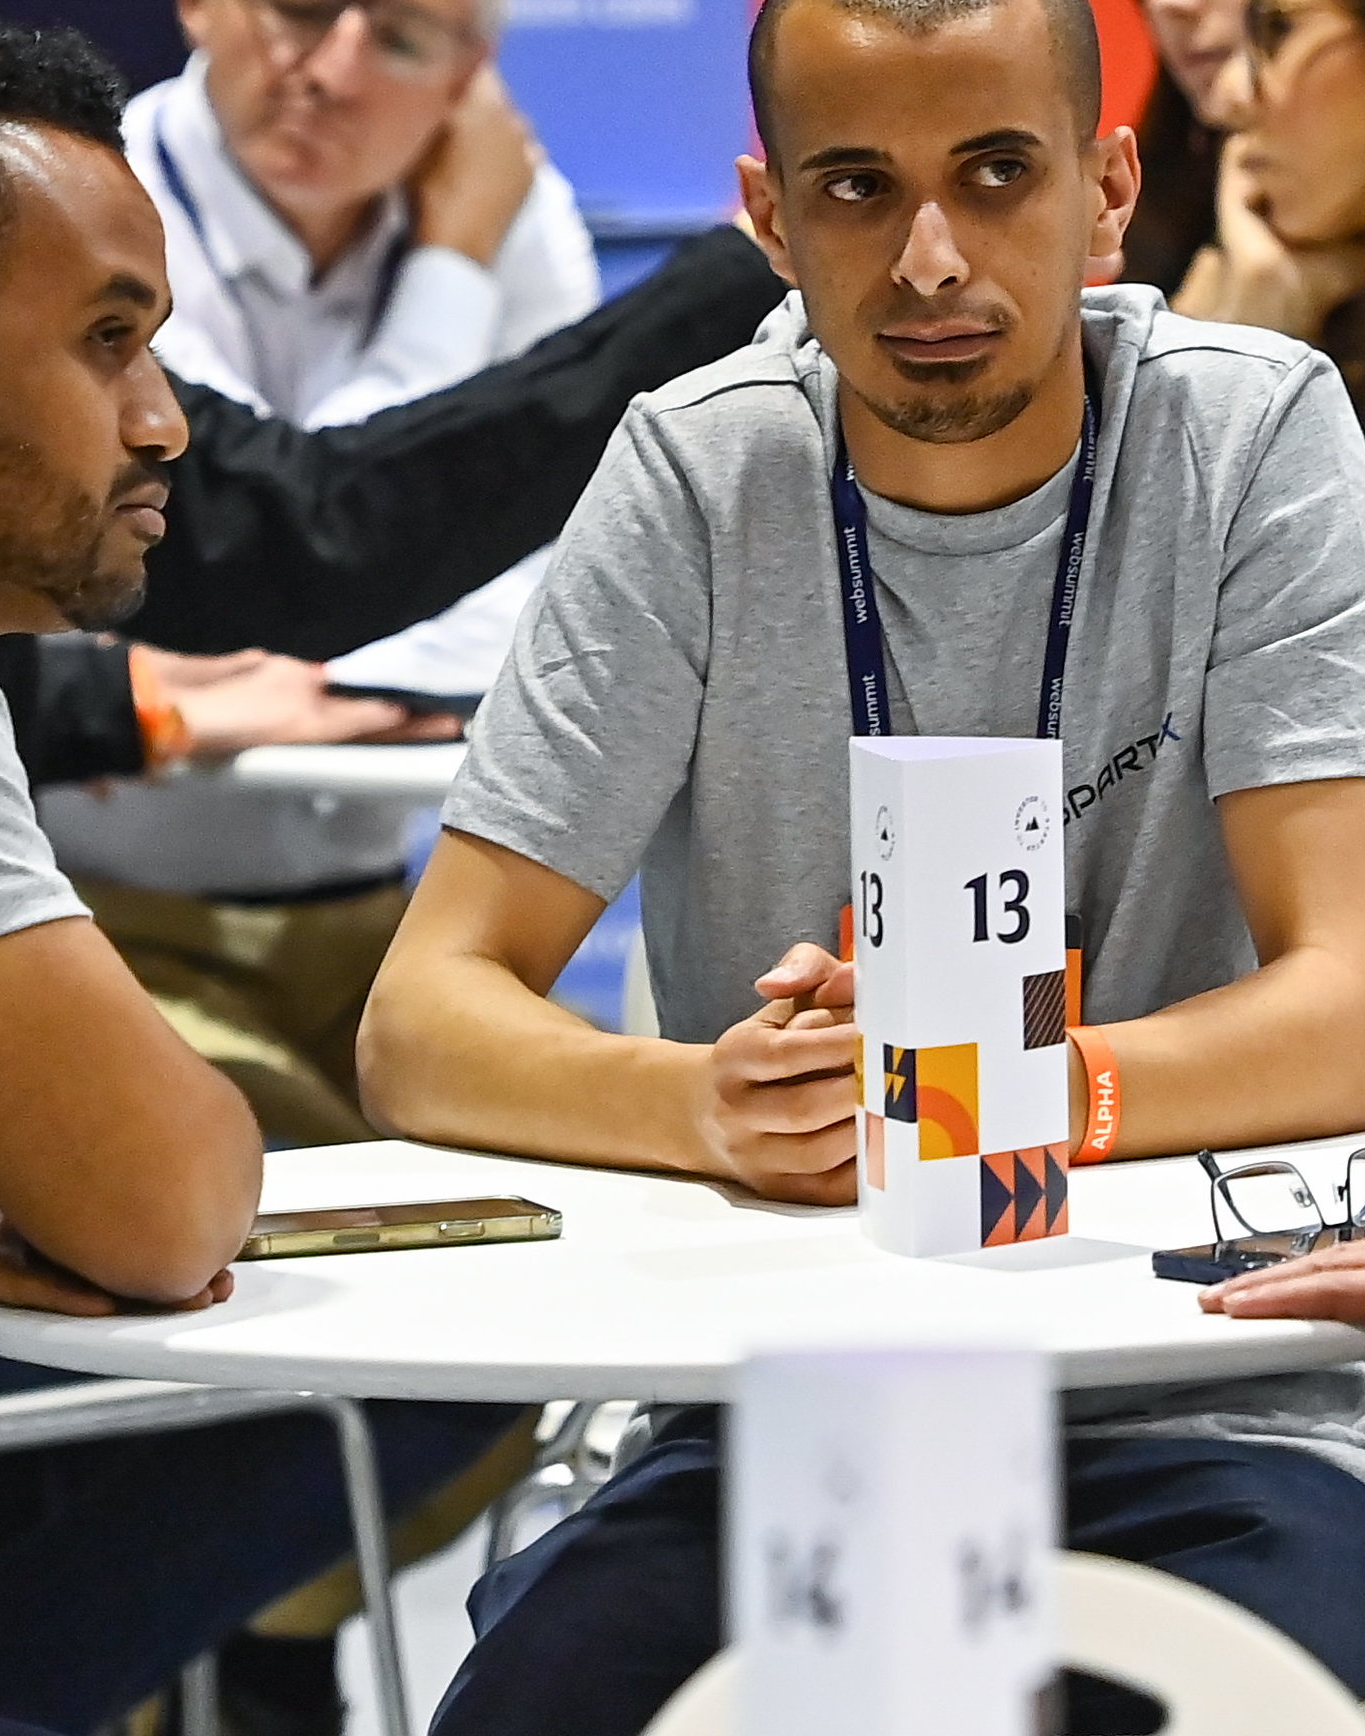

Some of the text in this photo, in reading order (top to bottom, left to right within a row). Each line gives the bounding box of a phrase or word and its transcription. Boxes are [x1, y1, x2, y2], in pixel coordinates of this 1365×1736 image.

[843, 525, 868, 624] websummit
[1057, 531, 1085, 626] websummit
[860, 870, 884, 948] 13
[963, 868, 1031, 945] 13
[1091, 1070, 1115, 1150] ALPHA
